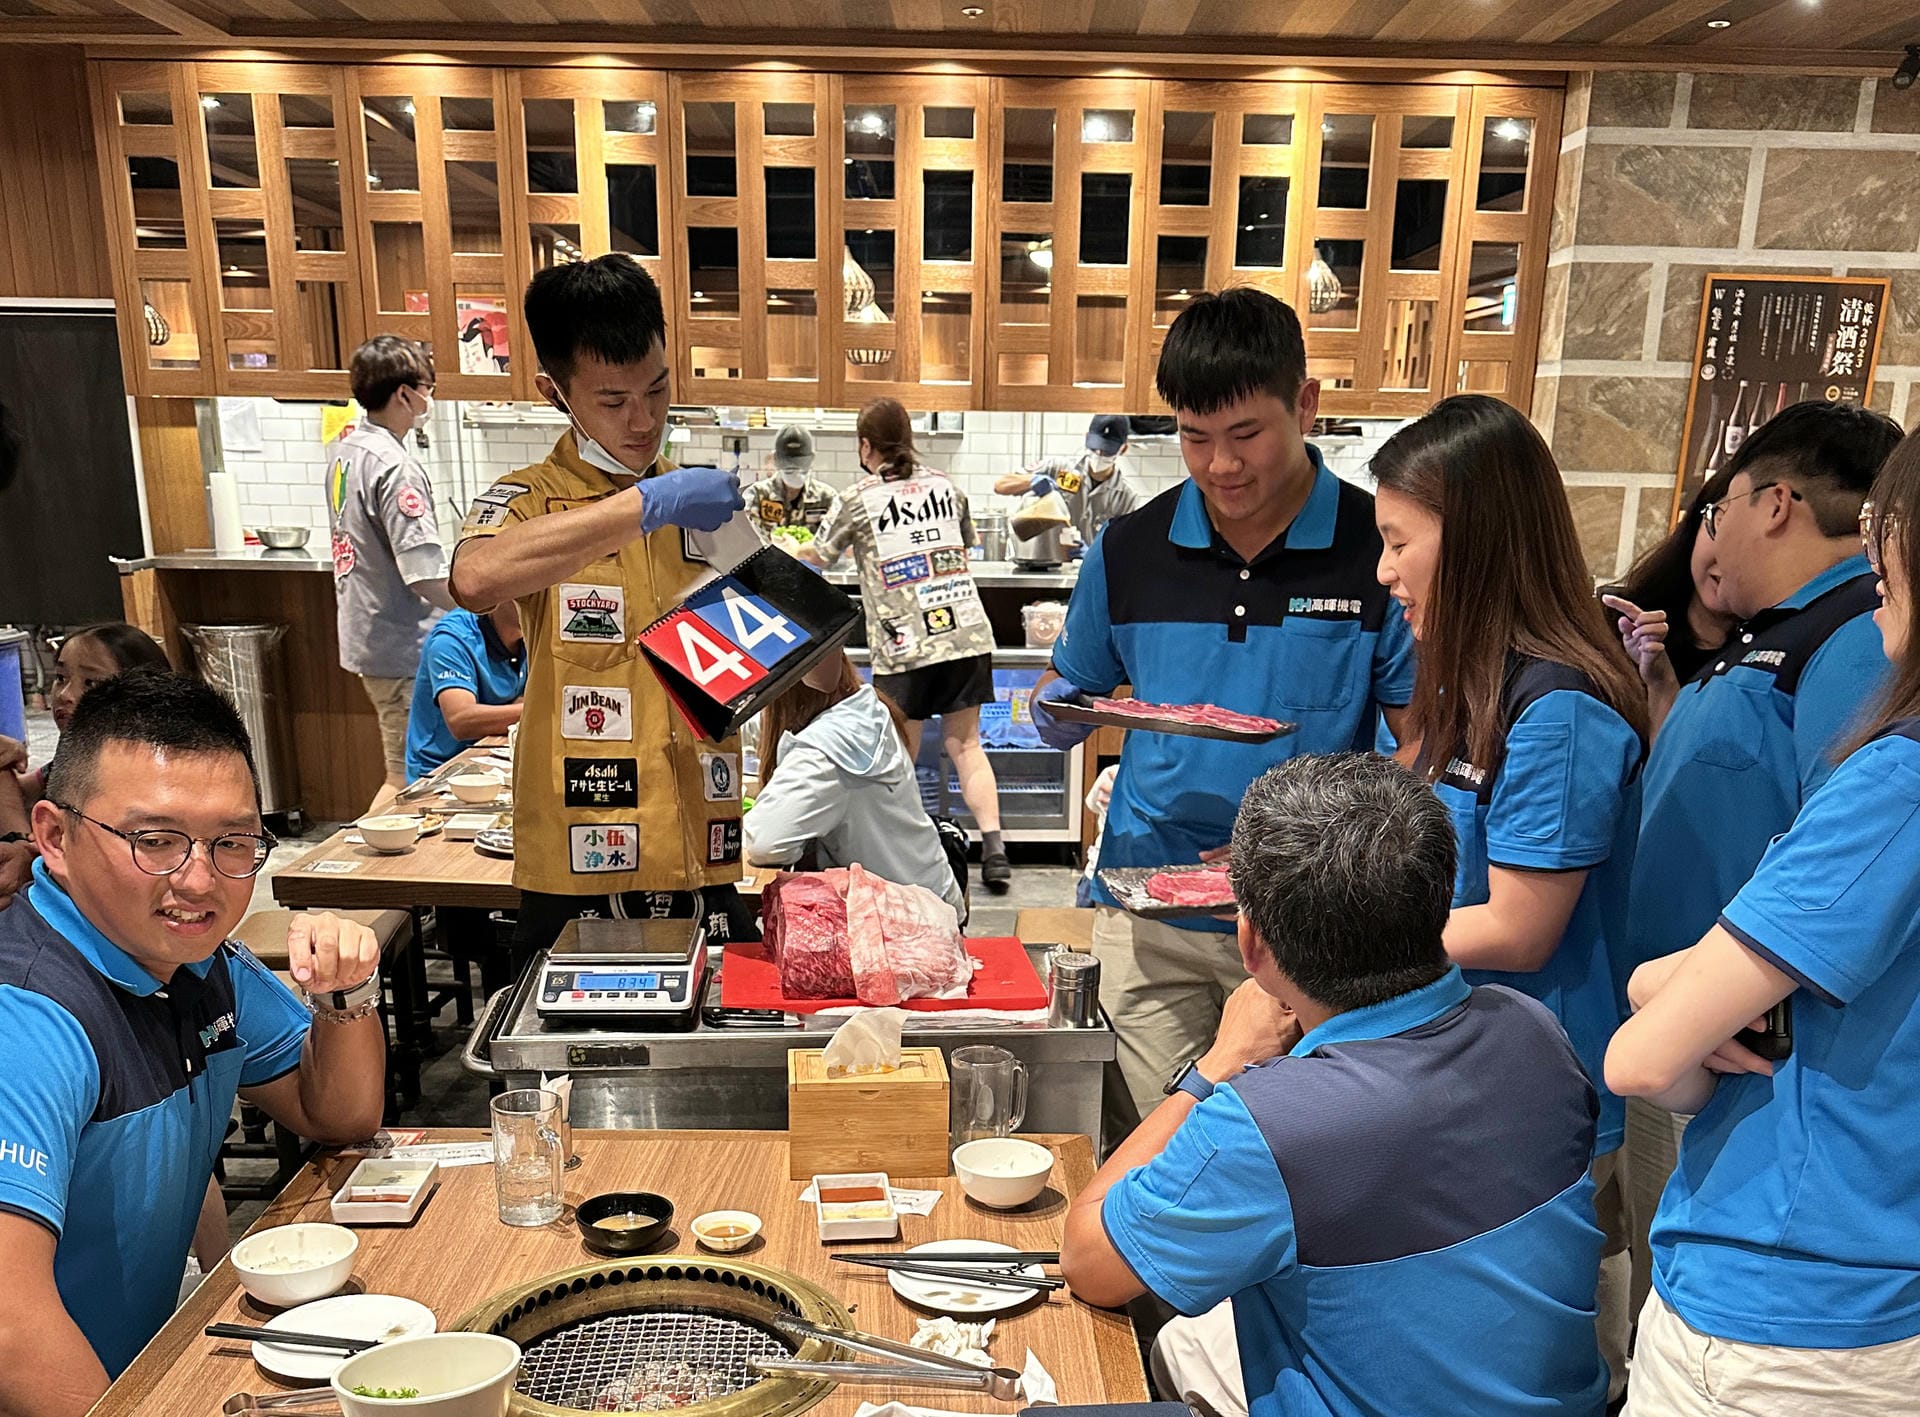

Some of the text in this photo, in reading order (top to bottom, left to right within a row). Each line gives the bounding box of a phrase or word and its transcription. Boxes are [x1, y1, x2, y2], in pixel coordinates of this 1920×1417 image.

[1826, 297, 1864, 377] 清酒祭
[878, 487, 953, 533] Asahi
[909, 527, 941, 545] 辛口
[568, 599, 617, 611] STOCKYARD
[676, 586, 797, 686] 4 4
[568, 690, 622, 717] JIM BEAM
[585, 764, 618, 778] Asahi
[570, 779, 633, 792] アサヒ生ビール
[0, 1139, 49, 1177] HUE
